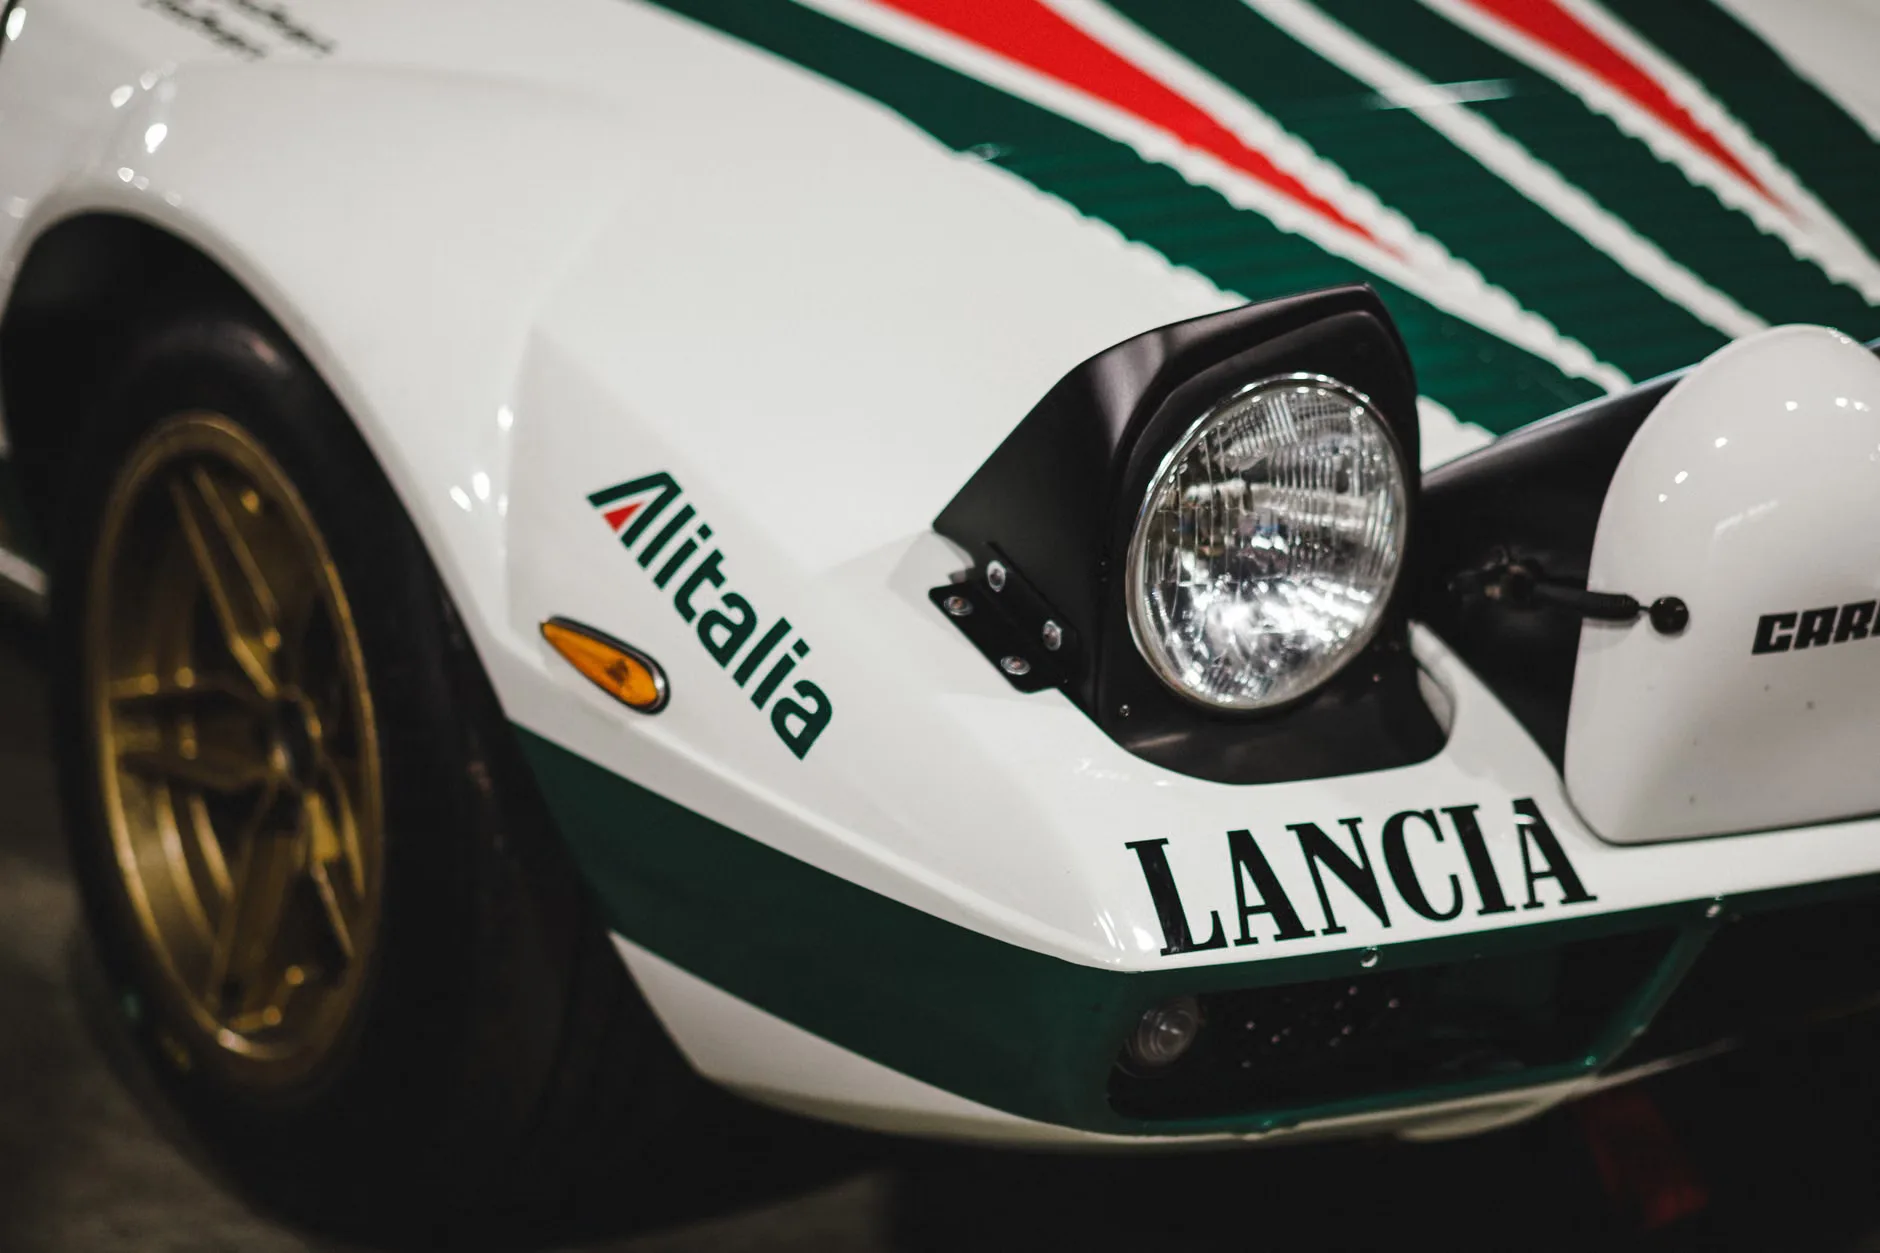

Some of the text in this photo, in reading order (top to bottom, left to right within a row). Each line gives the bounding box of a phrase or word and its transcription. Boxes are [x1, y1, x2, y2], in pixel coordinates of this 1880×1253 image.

[587, 471, 833, 761] Alitalia
[1752, 598, 1880, 655] CAR
[1124, 797, 1598, 957] LANCIA
